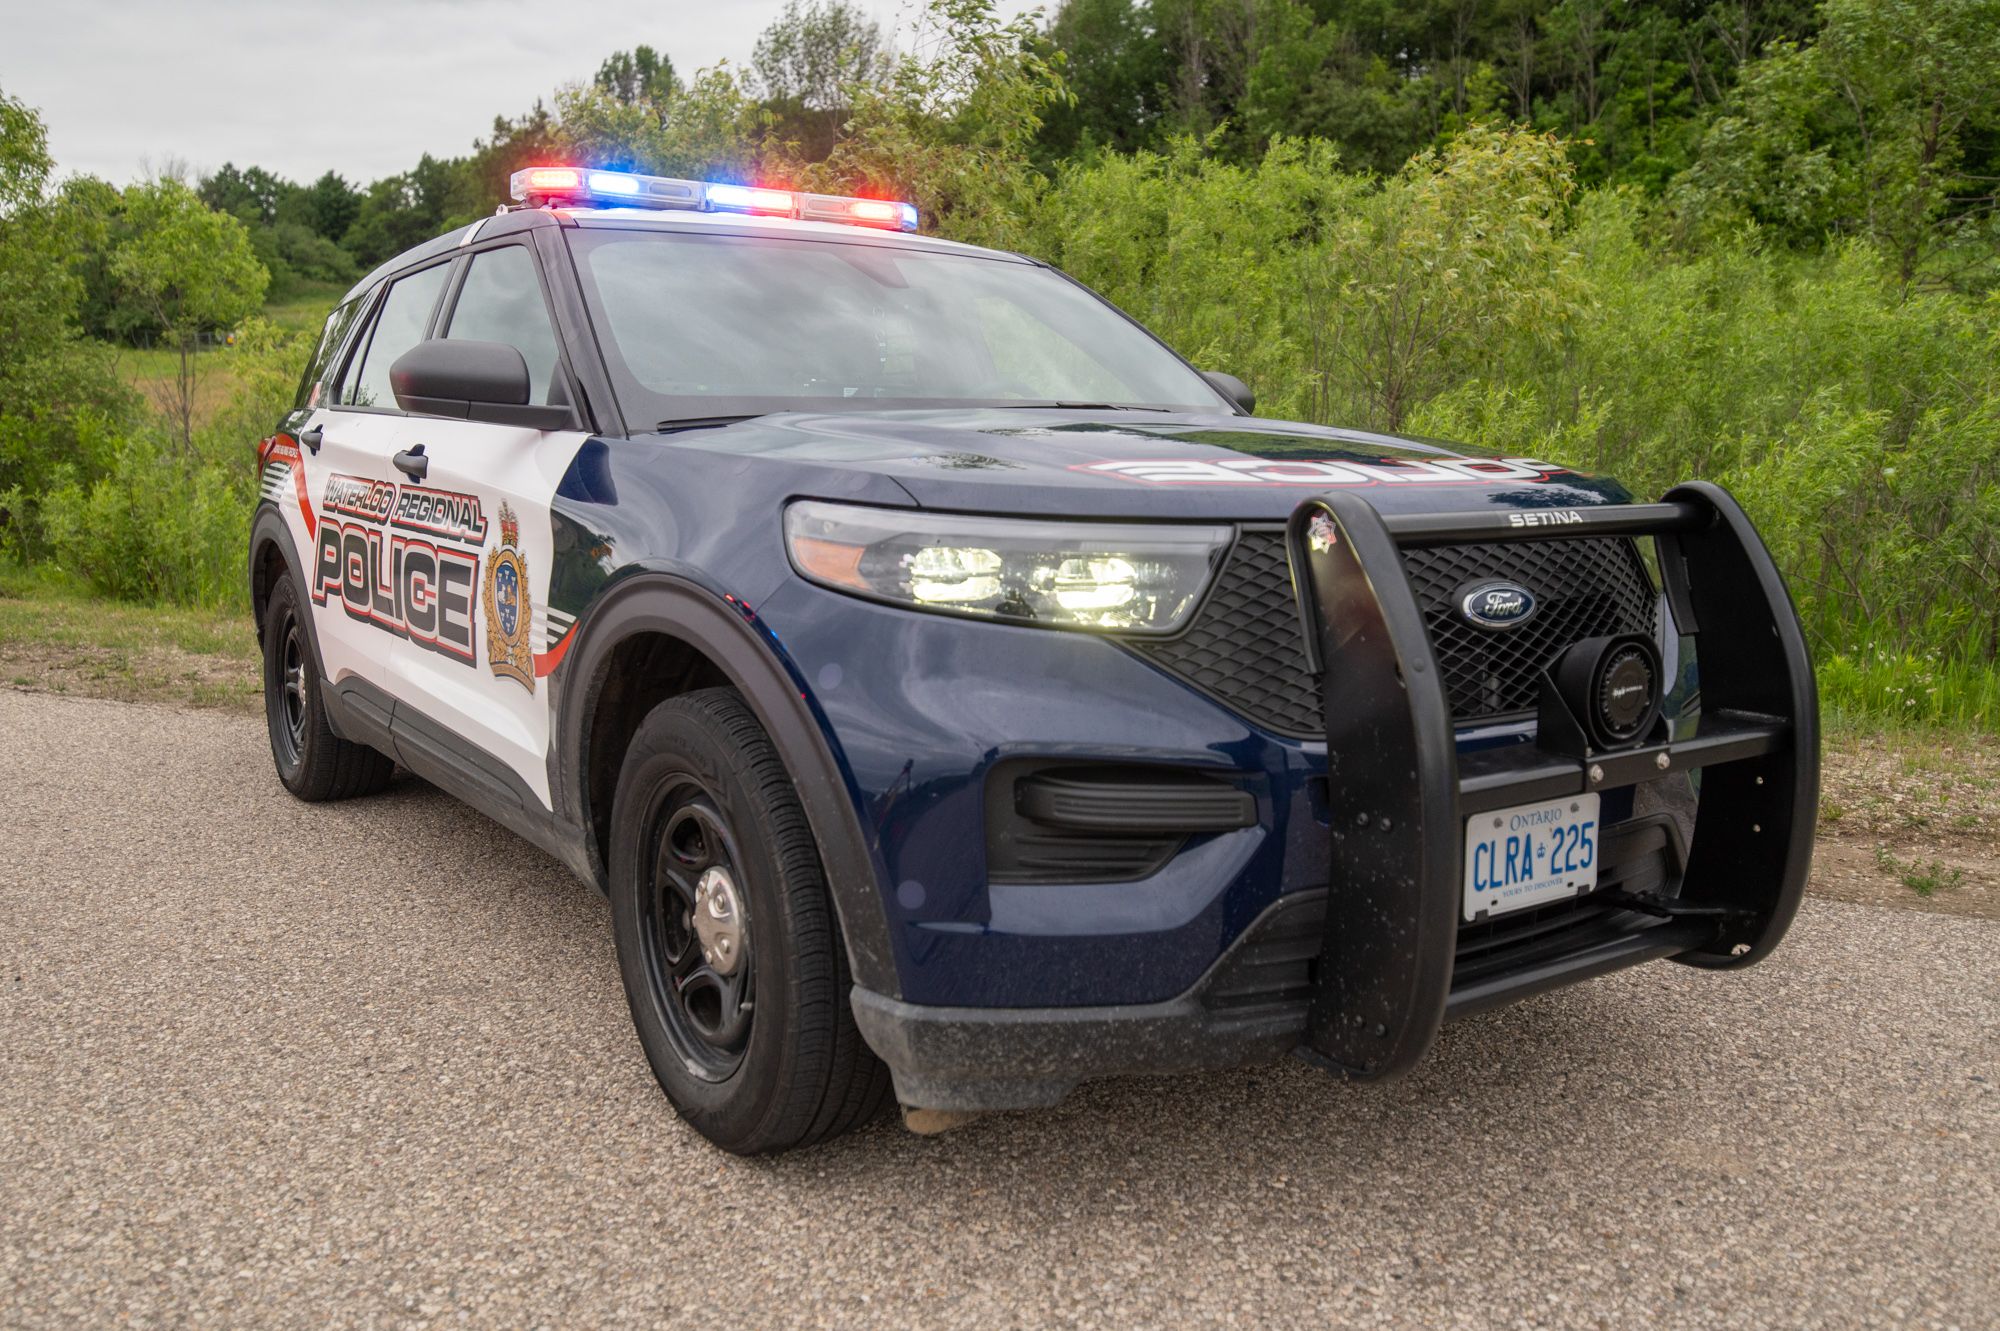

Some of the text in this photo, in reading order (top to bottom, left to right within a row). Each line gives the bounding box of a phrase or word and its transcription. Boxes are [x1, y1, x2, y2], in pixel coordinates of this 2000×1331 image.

[324, 475, 486, 540] WATERLOO REGIONAL
[1508, 510, 1583, 528] SETINA
[312, 517, 479, 668] POLICE
[1484, 591, 1524, 615] Ford
[1510, 808, 1562, 832] ONTARIO
[1474, 821, 1594, 892] CLRA 225
[1524, 884, 1534, 893] TO
[1534, 878, 1563, 890] DISCOVER
